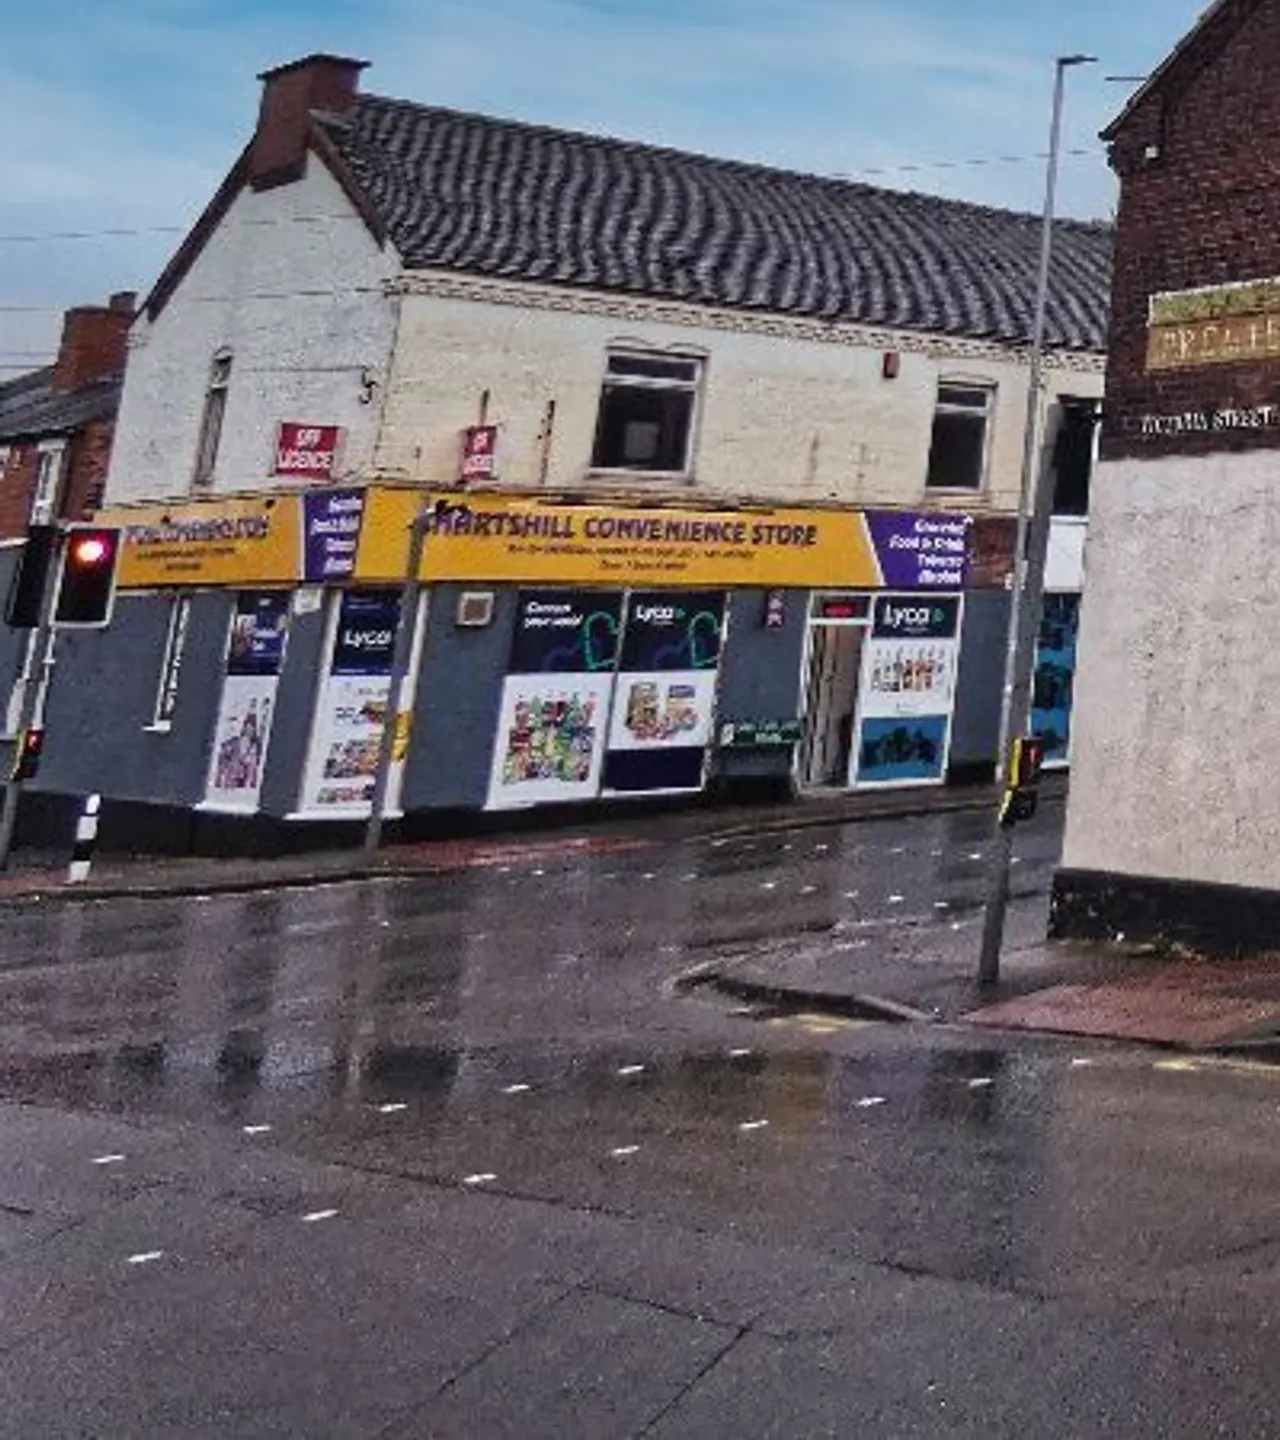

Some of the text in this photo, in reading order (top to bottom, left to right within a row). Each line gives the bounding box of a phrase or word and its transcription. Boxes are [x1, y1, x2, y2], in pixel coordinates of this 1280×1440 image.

[1212, 405, 1272, 429] STREET
[584, 517, 747, 544] CONVENIENCE
[751, 523, 818, 546] STORE
[882, 604, 930, 629] Lyca
